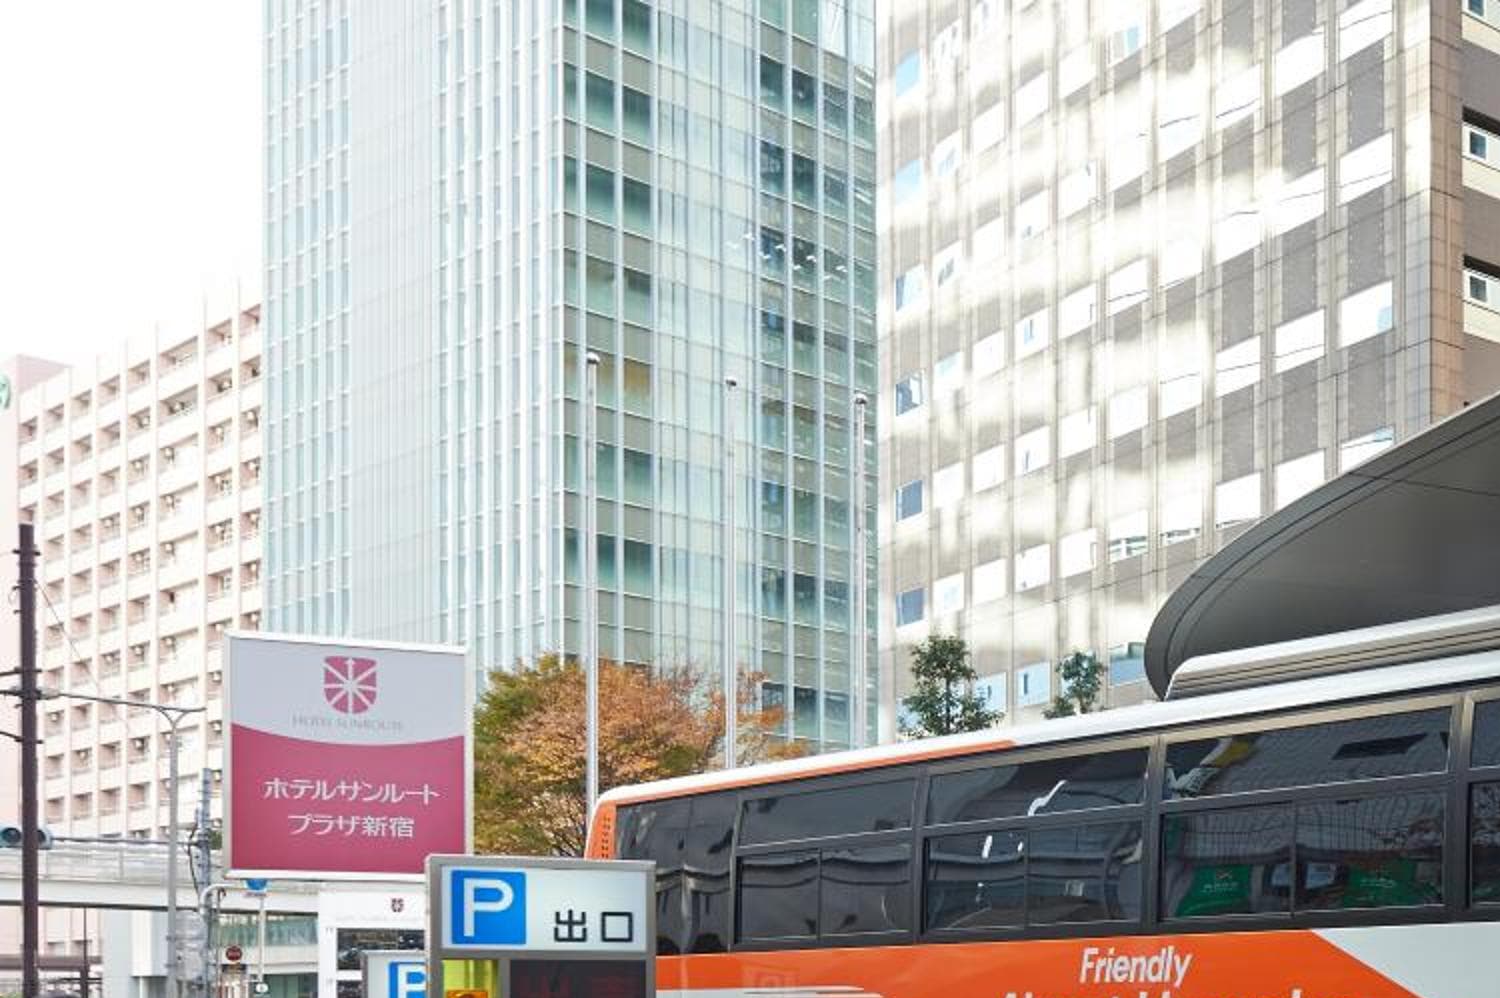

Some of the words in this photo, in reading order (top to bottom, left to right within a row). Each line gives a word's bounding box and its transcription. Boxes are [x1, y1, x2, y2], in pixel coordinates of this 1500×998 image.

[263, 778, 440, 805] ホテルサンルート
[288, 814, 415, 838] プラザ新宿
[463, 878, 514, 937] P
[554, 909, 634, 943] 出口
[1079, 945, 1194, 988] Friendly
